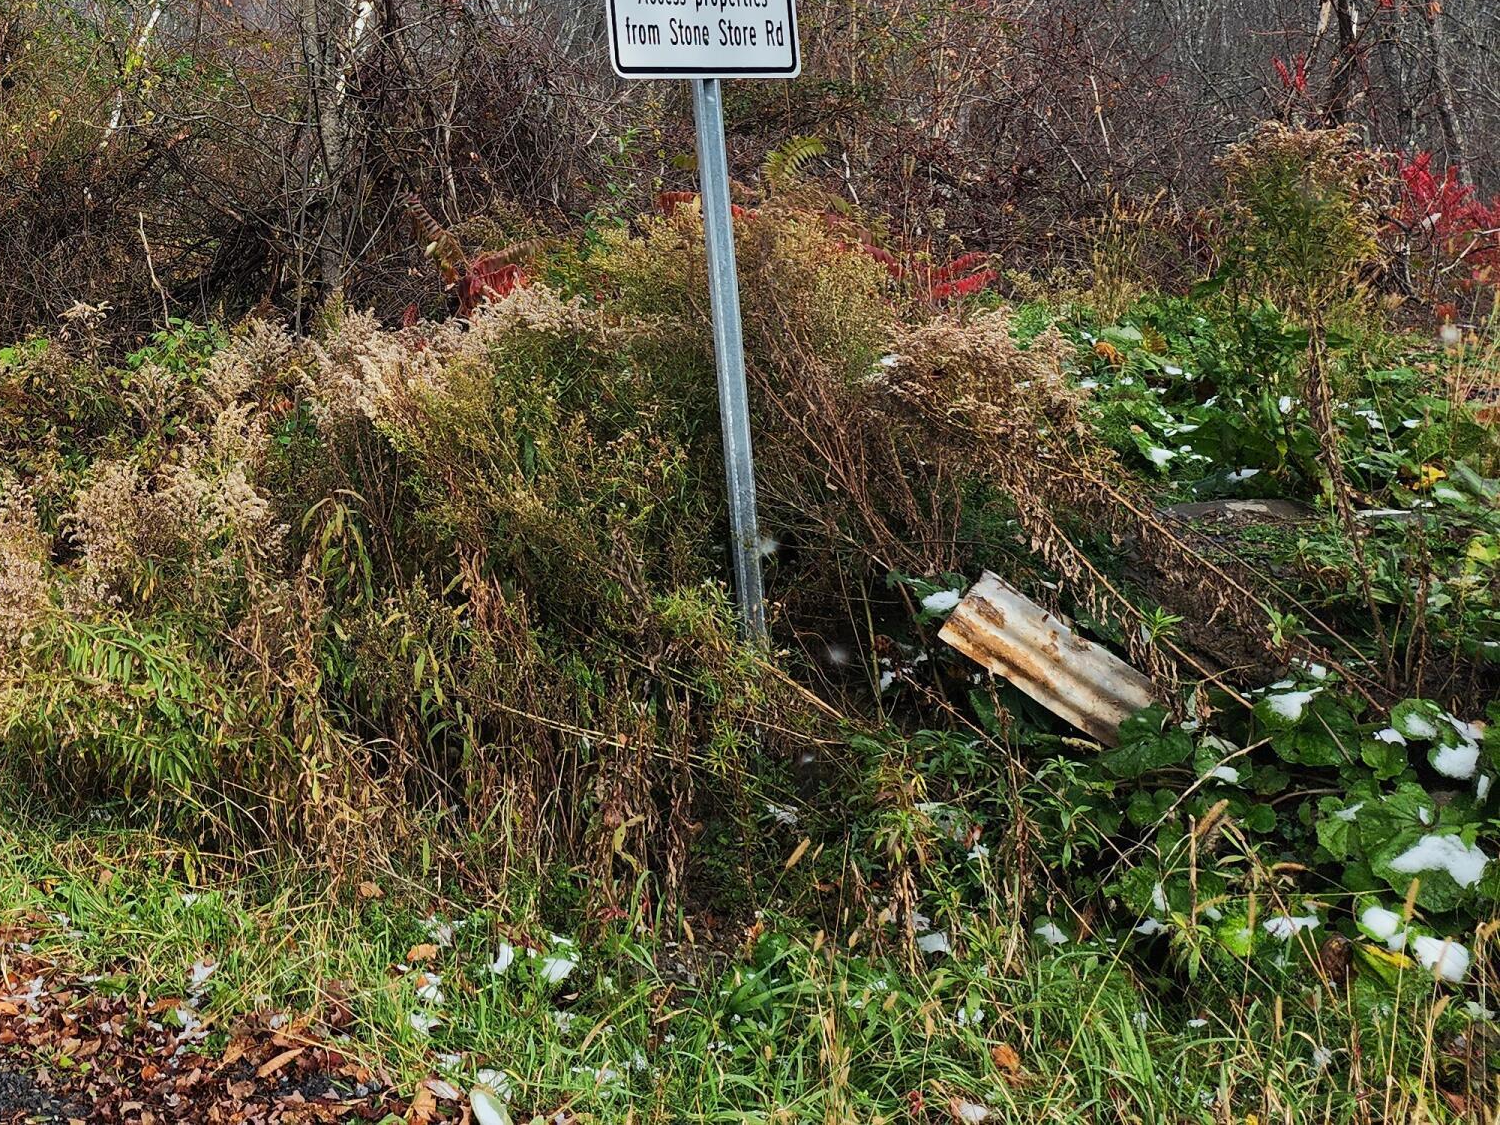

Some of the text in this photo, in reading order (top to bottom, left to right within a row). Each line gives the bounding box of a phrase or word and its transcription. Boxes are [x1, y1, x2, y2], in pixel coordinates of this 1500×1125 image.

[626, 17, 784, 46] from Stone Store Rd
